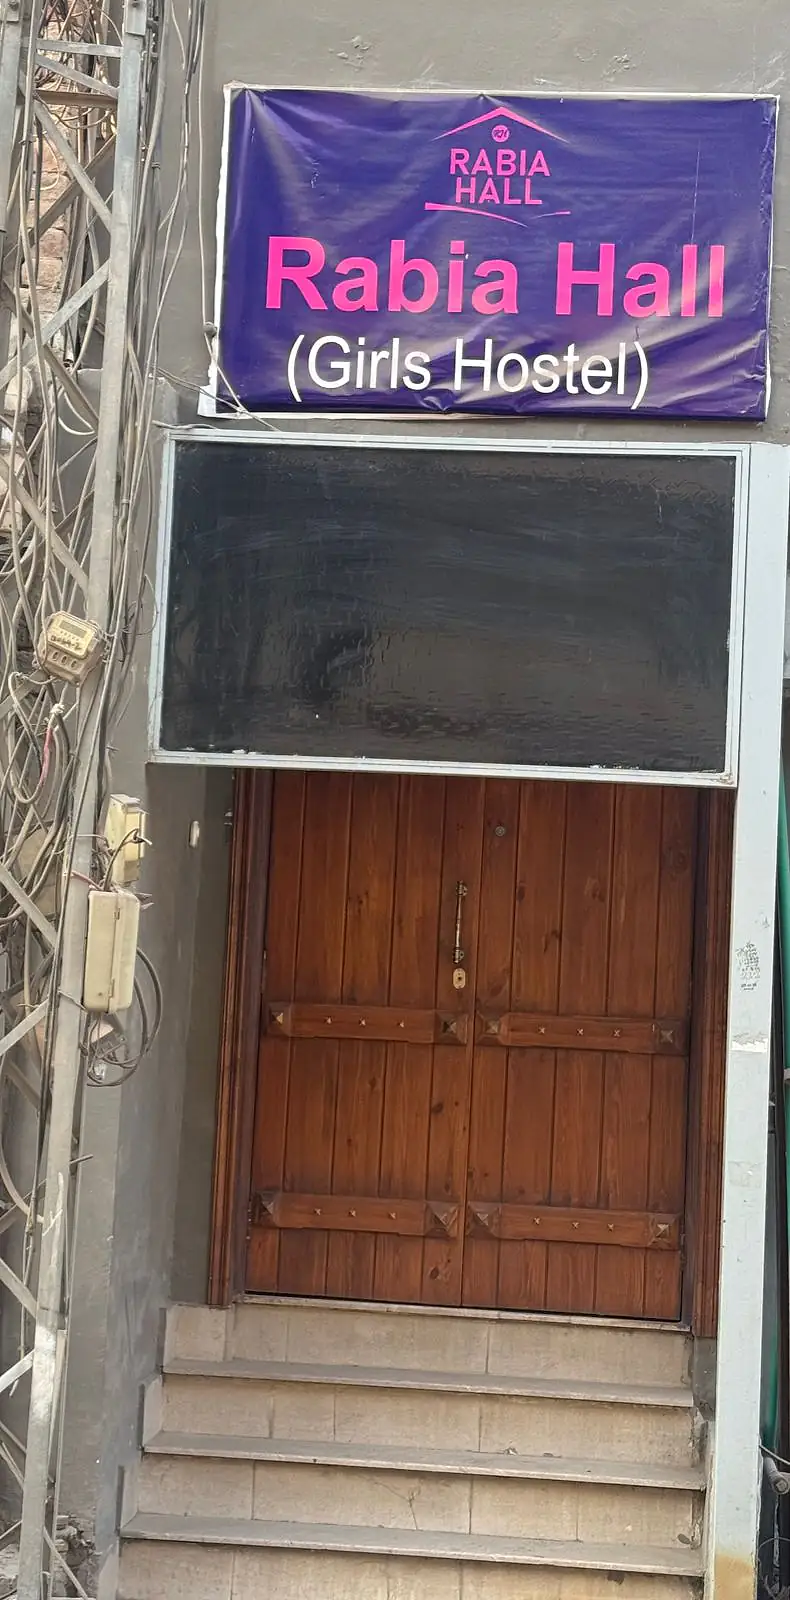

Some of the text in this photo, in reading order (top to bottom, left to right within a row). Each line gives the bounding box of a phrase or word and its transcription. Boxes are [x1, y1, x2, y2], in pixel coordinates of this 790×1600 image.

[449, 148, 550, 176] RABIA
[455, 176, 542, 205] HALL
[265, 236, 725, 318] Rabia Hall
[286, 334, 649, 410] (Girls Hostel)
